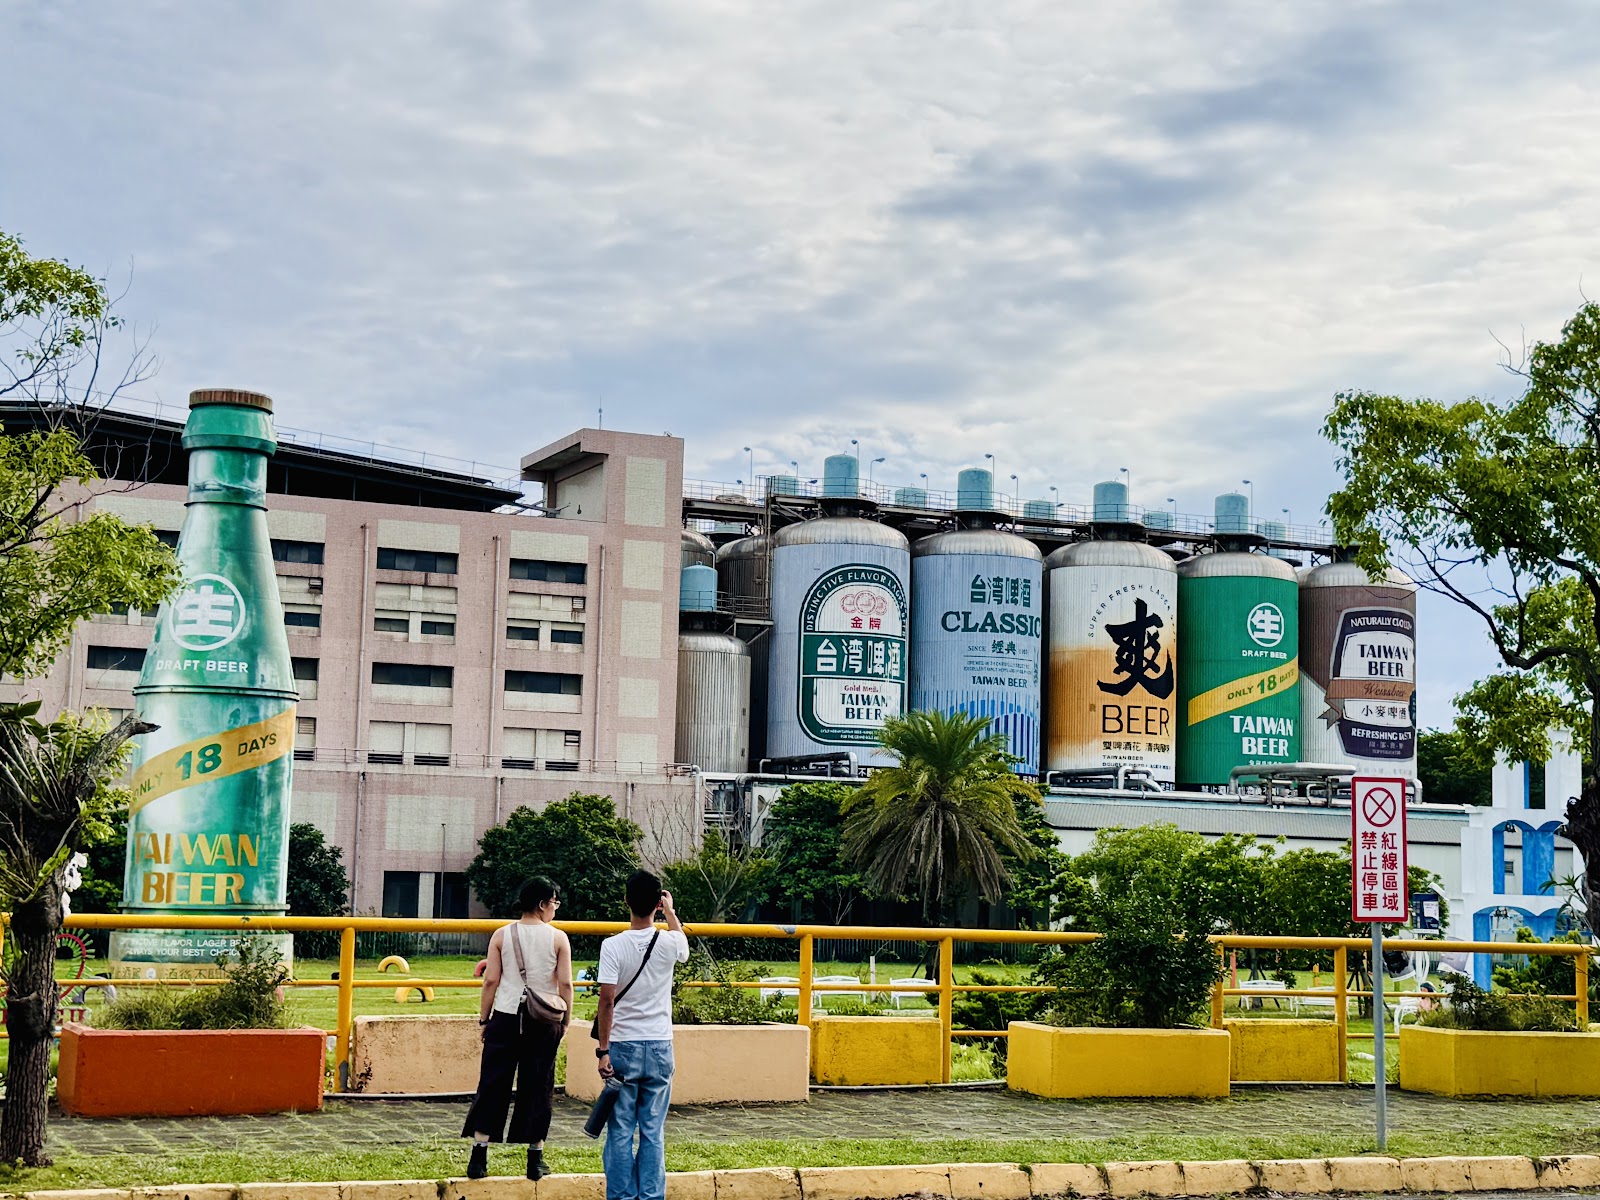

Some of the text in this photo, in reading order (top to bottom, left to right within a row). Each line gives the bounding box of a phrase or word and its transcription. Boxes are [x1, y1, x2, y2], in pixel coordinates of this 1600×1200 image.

[174, 585, 235, 638] 生
[806, 574, 844, 631] DISTINCTIVE
[847, 571, 887, 583] FLAVOR
[1087, 602, 1107, 638] SUPER
[1108, 584, 1143, 601] FRESH
[850, 615, 882, 631] 金牌
[942, 611, 1041, 639] CLASSIC
[1251, 609, 1281, 640] 生
[1350, 617, 1392, 628] NATURALLY
[991, 639, 1017, 655] 經典
[1096, 597, 1174, 700] 爽
[1241, 649, 1288, 660] DRAFT BEER
[1356, 643, 1409, 661] TAIWAN
[155, 660, 249, 674] DRAFT BEER
[1367, 660, 1404, 678] BEER
[844, 684, 861, 692] Gold
[971, 675, 1028, 688] TAIWAN BEER
[1227, 685, 1254, 700] ONLY
[1256, 674, 1277, 695] 18
[840, 692, 889, 708] TAIWAN
[845, 707, 883, 721] BEER
[1102, 704, 1170, 737] BEER
[1229, 715, 1294, 737] TAIWAN
[1351, 727, 1398, 741] REFRESHING
[175, 742, 223, 781] 18
[237, 732, 278, 757] DAYS
[1242, 736, 1289, 757] BEER
[134, 832, 261, 867] TAIWAN
[1361, 830, 1378, 912] 禁止停車
[1381, 831, 1399, 912] 紅線區域
[141, 871, 246, 905] BEER
[156, 948, 180, 956] YOUR
[182, 948, 206, 957] BEST
[196, 940, 227, 948] LAGER
